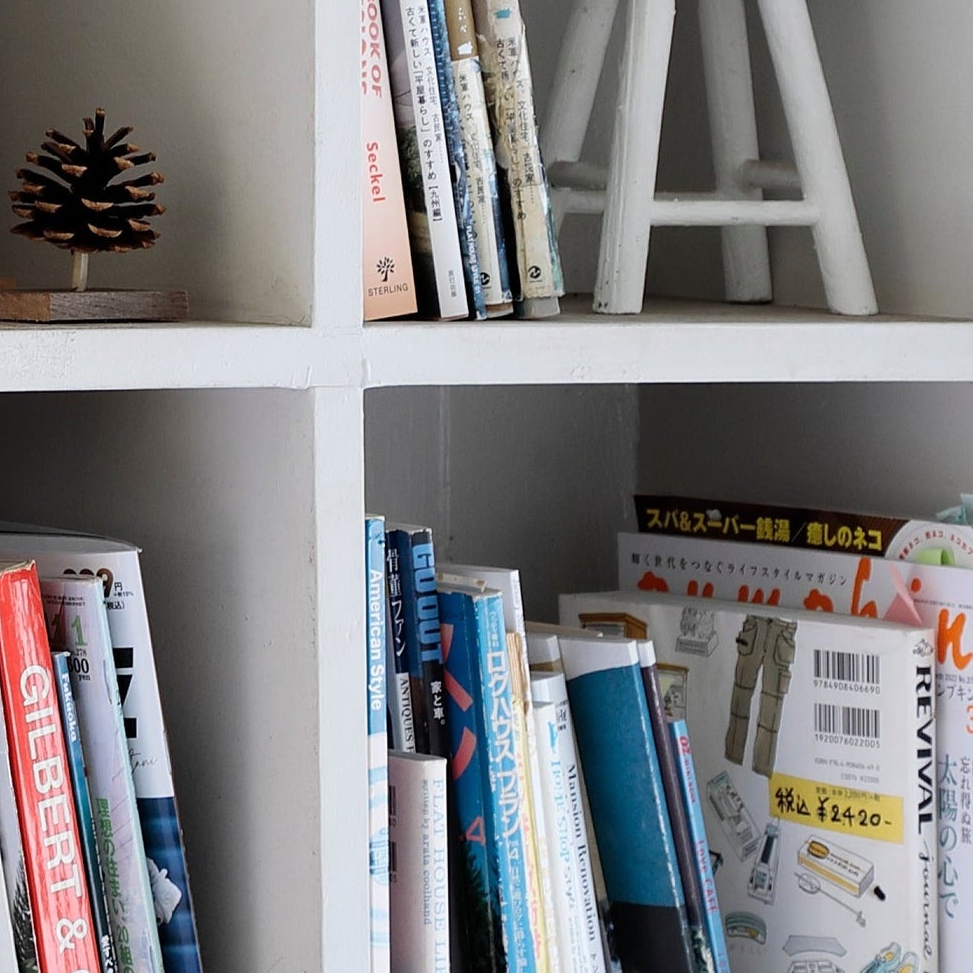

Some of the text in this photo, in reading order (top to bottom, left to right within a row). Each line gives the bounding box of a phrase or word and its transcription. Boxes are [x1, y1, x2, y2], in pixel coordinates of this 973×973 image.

[370, 64, 382, 99] OF
[366, 142, 386, 203] Seckel
[368, 283, 409, 297] STERLING
[386, 548, 406, 658] 骨董ファン
[368, 569, 385, 711] American Style
[61, 672, 77, 742] Fukuoka
[400, 679, 415, 746] ANTIQUES
[916, 665, 933, 835] REVIVAL
[20, 664, 84, 899] GILBERT
[55, 917, 89, 955] &
[433, 778, 445, 835] FLAT
[775, 787, 811, 816] 税込
[423, 832, 431, 866] arata
[568, 764, 583, 838] Mansion
[577, 845, 597, 941] Renovation
[938, 754, 958, 919] 太陽の心で
[423, 869, 432, 925] coolhand
[433, 848, 447, 931] HOUSE
